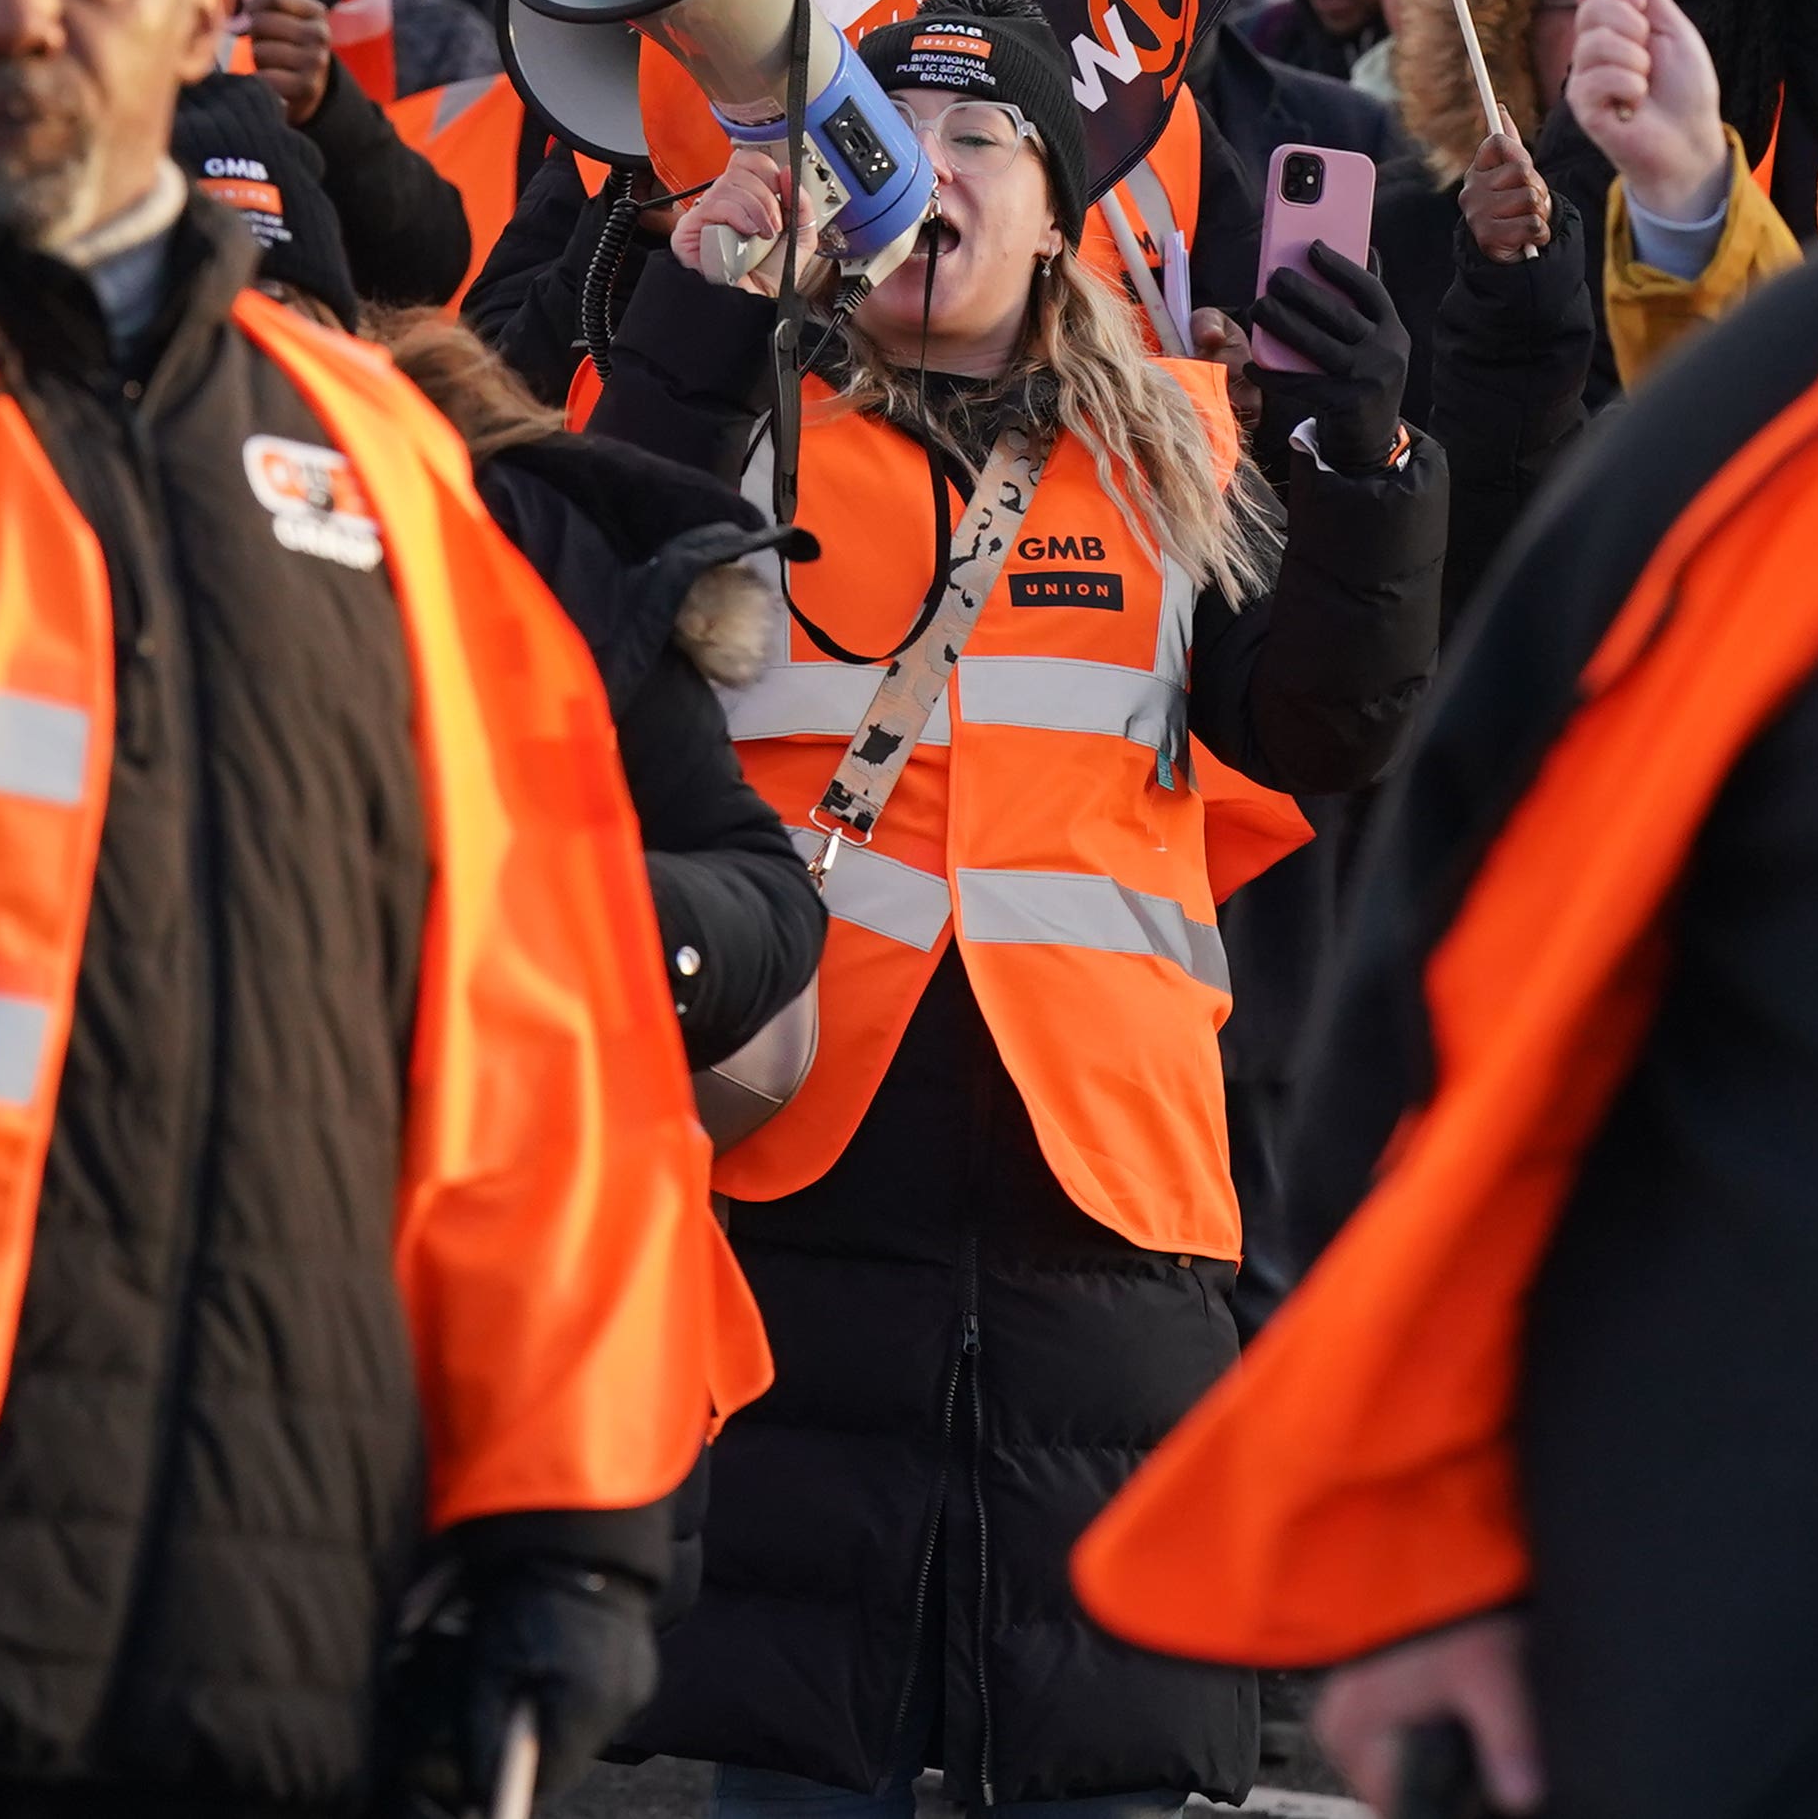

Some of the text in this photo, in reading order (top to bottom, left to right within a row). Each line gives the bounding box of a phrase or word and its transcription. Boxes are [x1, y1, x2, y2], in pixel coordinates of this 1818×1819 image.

[925, 23, 983, 38] GMB
[923, 38, 979, 50] UNION
[911, 53, 986, 71] BIRMINGHAM
[896, 63, 996, 86] PUBLIC SERVICES
[919, 72, 970, 86] BRANCH
[1017, 535, 1106, 561] GMB
[1025, 583, 1109, 598] UNION
